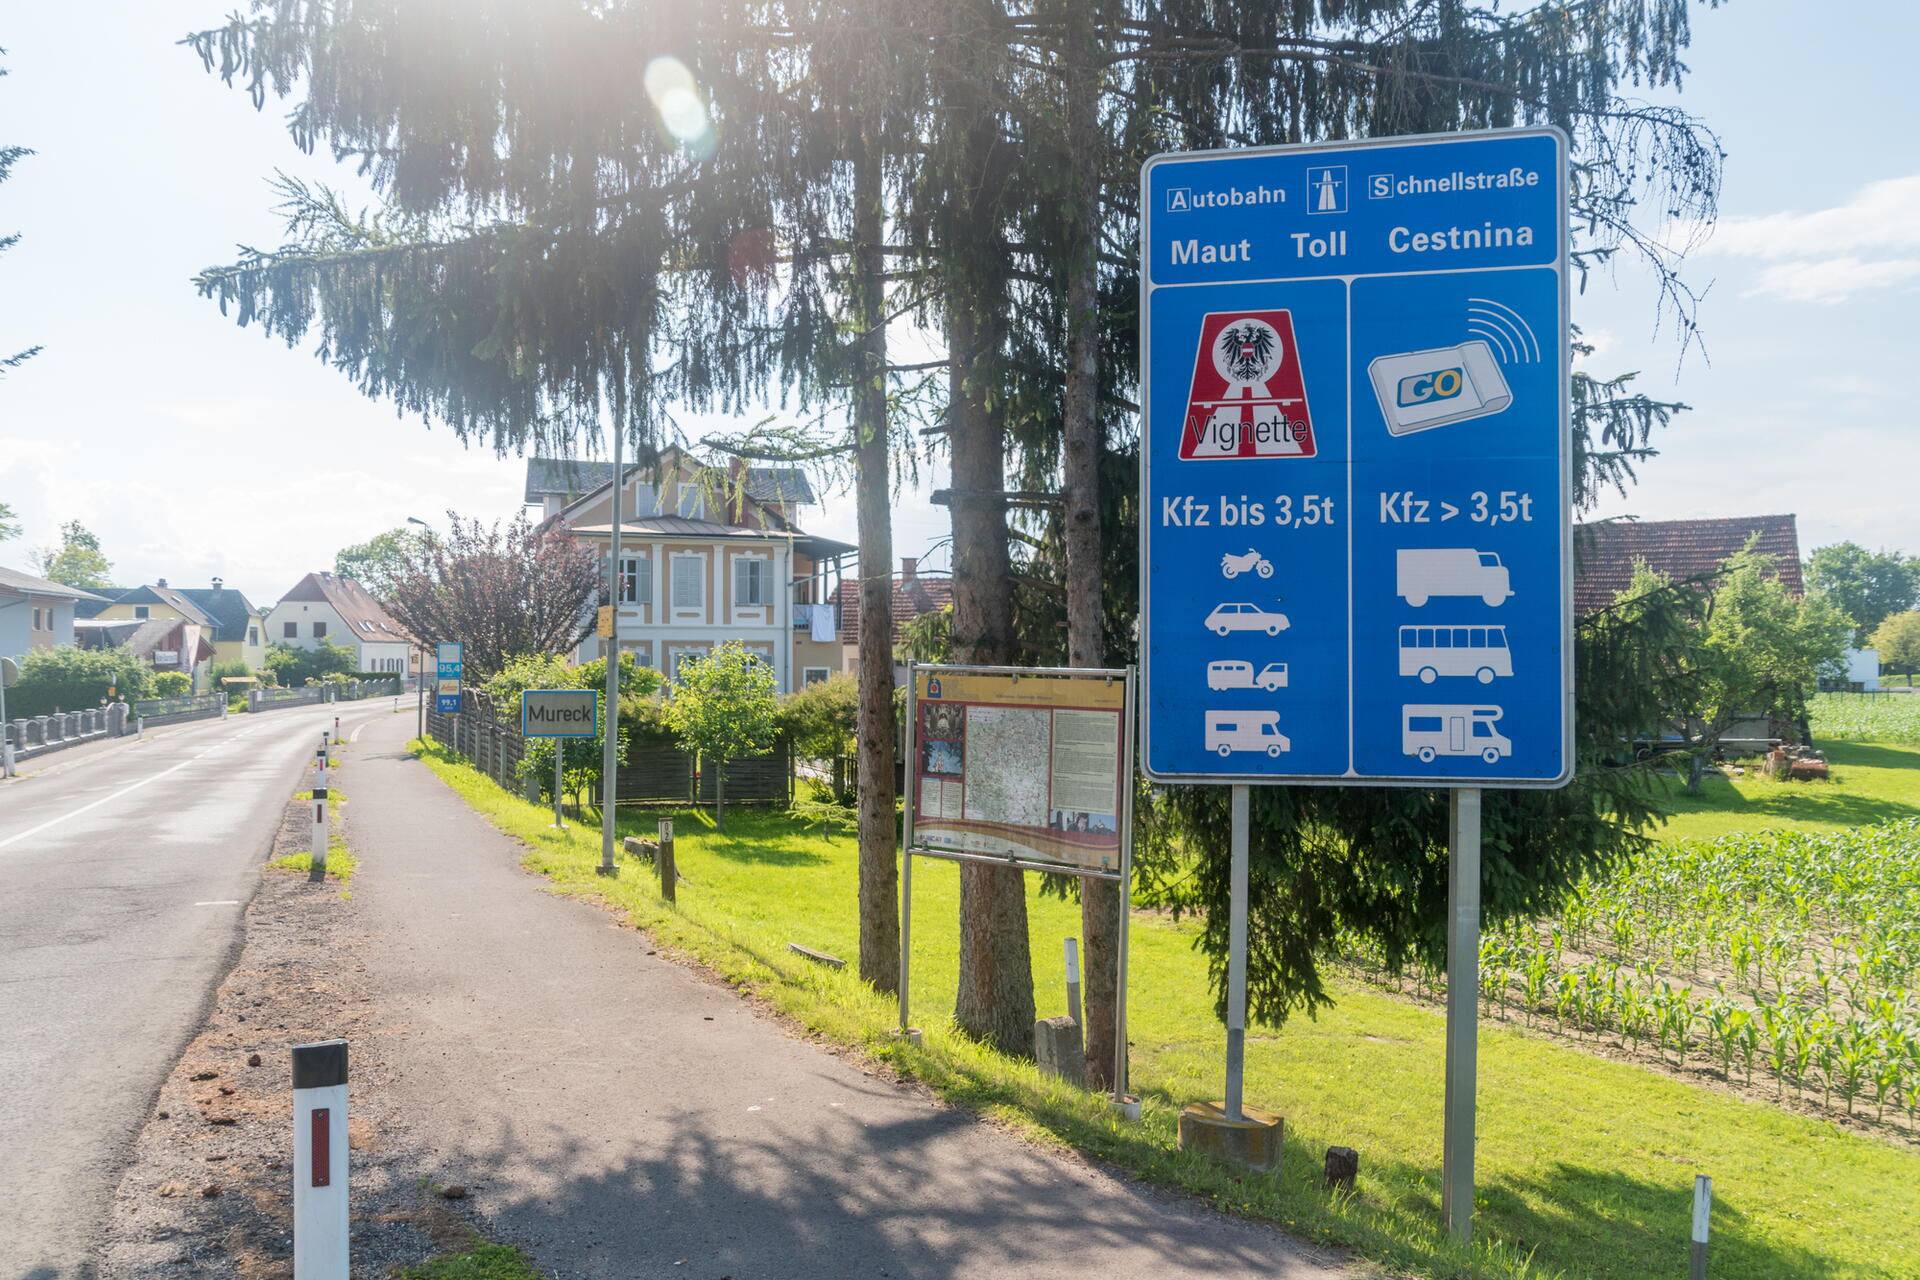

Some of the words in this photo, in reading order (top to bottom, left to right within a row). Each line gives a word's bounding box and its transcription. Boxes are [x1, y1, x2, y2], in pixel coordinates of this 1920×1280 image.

[1168, 185, 1286, 213] Autobahn
[1369, 167, 1539, 200] Schnellstraße
[1170, 239, 1251, 265] Maut
[1290, 230, 1347, 258] Toll
[1388, 221, 1534, 254] Cestnina
[1401, 369, 1462, 405] GO
[1190, 414, 1308, 451] Vignette
[1163, 495, 1210, 527] Kfz
[1220, 495, 1265, 526] bis
[1275, 494, 1335, 530] 3,5t
[1380, 490, 1430, 523] Kfz
[1470, 490, 1534, 528] 3,5t
[439, 663, 460, 674] 95,4
[528, 704, 592, 722] Mureck
